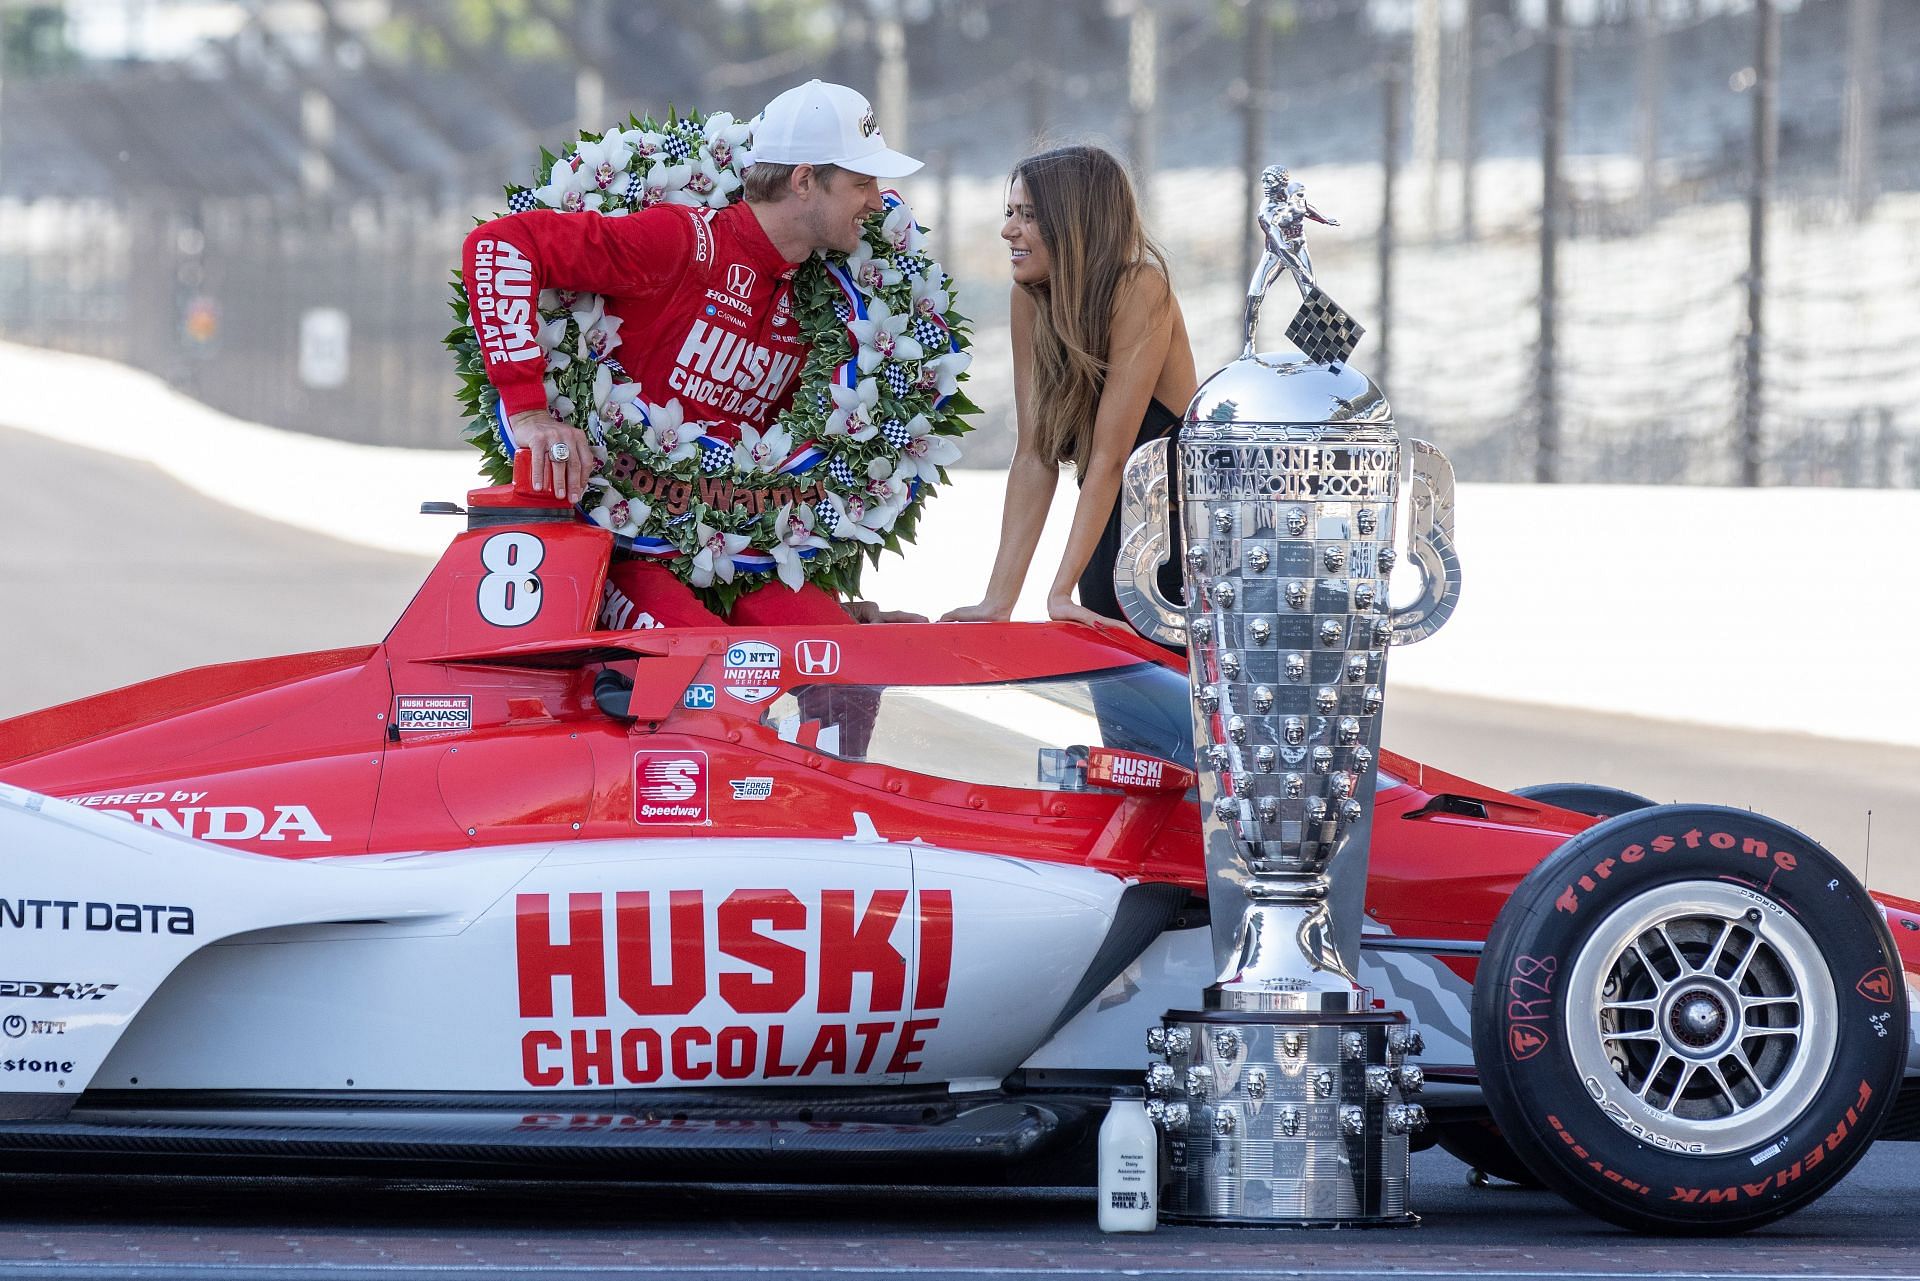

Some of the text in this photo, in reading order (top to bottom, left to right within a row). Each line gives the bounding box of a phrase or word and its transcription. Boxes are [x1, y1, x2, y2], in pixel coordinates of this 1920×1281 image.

[475, 239, 509, 365] CHOCOLATE
[495, 240, 541, 362] HUSKI
[704, 288, 753, 317] HONDA
[676, 318, 800, 401] HUSKI
[613, 451, 693, 516] Borg
[477, 530, 546, 629] 8
[749, 652, 776, 663] NTT
[724, 669, 780, 680] INDYCAR
[401, 700, 467, 708] HUSKI CHOCOLATE
[686, 686, 714, 707] PPG
[412, 710, 468, 721] GANASSI
[1112, 756, 1163, 779] HUSKI
[747, 788, 770, 796] GOOD
[1112, 774, 1161, 788] CHOCOLATE
[169, 790, 209, 803] by
[640, 804, 701, 818] Speedway
[1555, 828, 1798, 914] Firestone
[515, 888, 954, 1018] HUSKI
[0, 982, 43, 998] PD
[1508, 955, 1557, 1021] R28
[30, 1020, 67, 1035] NTT
[520, 1017, 940, 1087] CHOCOLATE
[0, 1057, 73, 1073] stone
[1631, 1124, 1703, 1153] RACING
[1669, 1079, 1873, 1204] FIREHAWK
[1111, 1201, 1136, 1209] MILK
